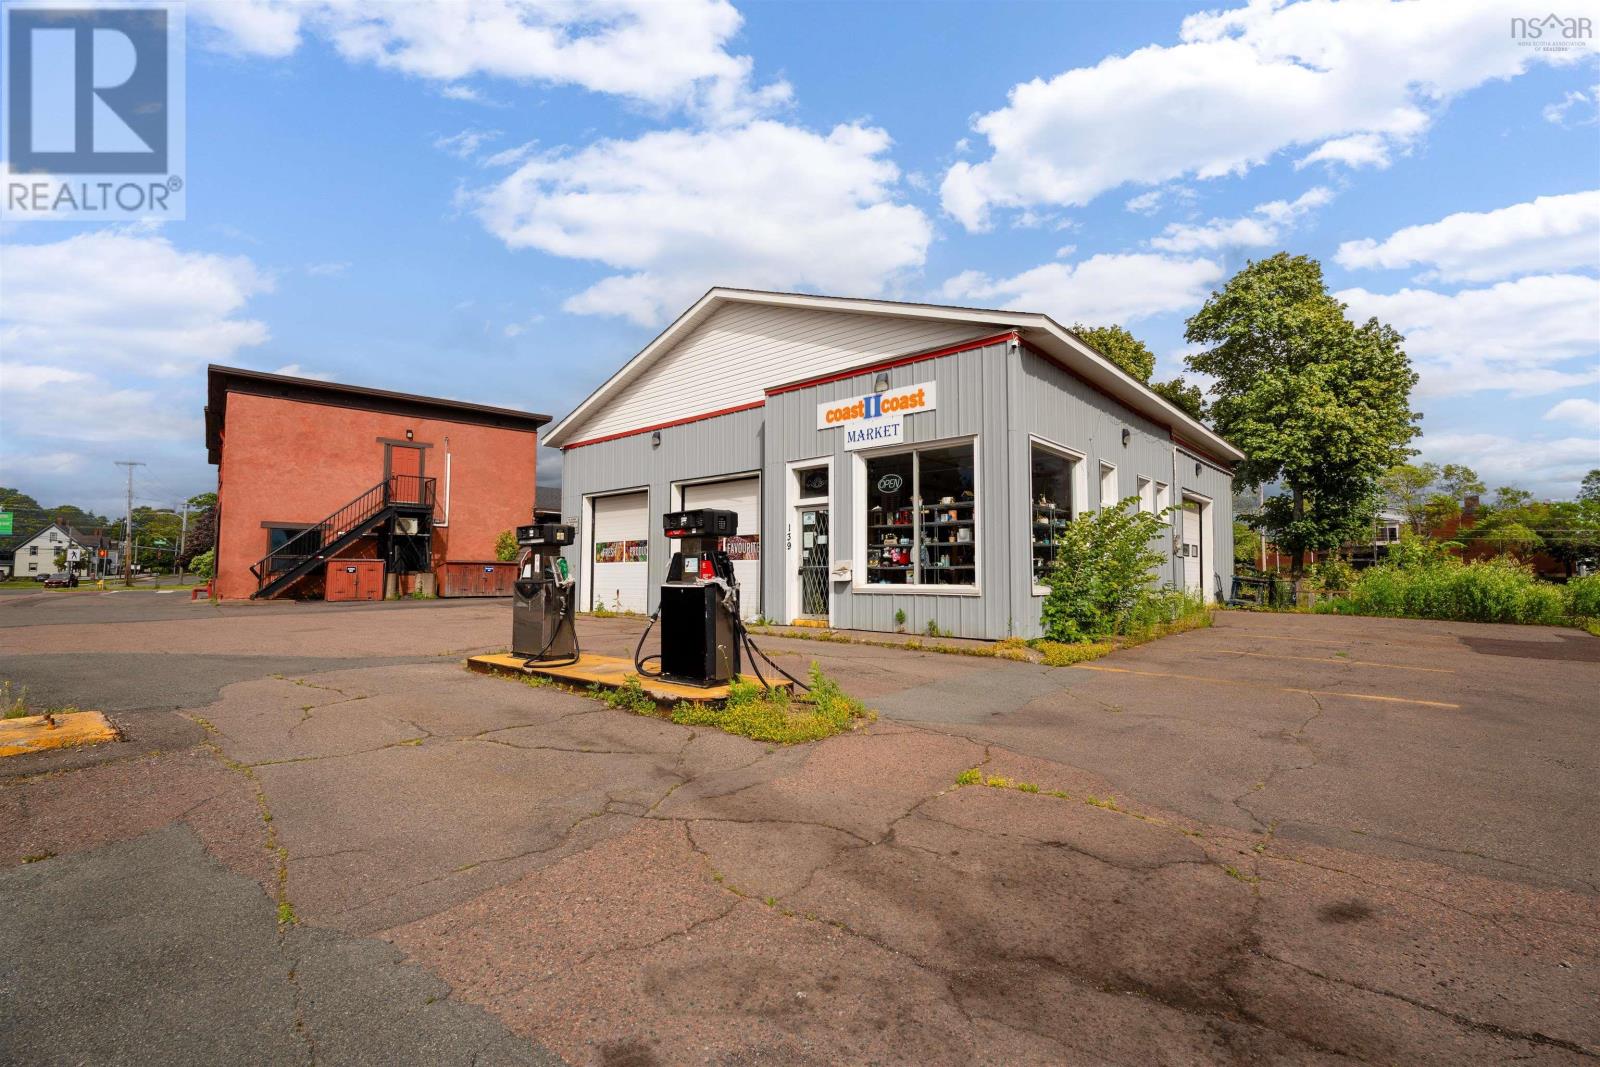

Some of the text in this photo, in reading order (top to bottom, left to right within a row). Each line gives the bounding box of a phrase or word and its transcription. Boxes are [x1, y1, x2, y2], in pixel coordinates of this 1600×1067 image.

[826, 400, 864, 423] coast
[881, 388, 925, 413] coast
[847, 423, 900, 443] MARKET
